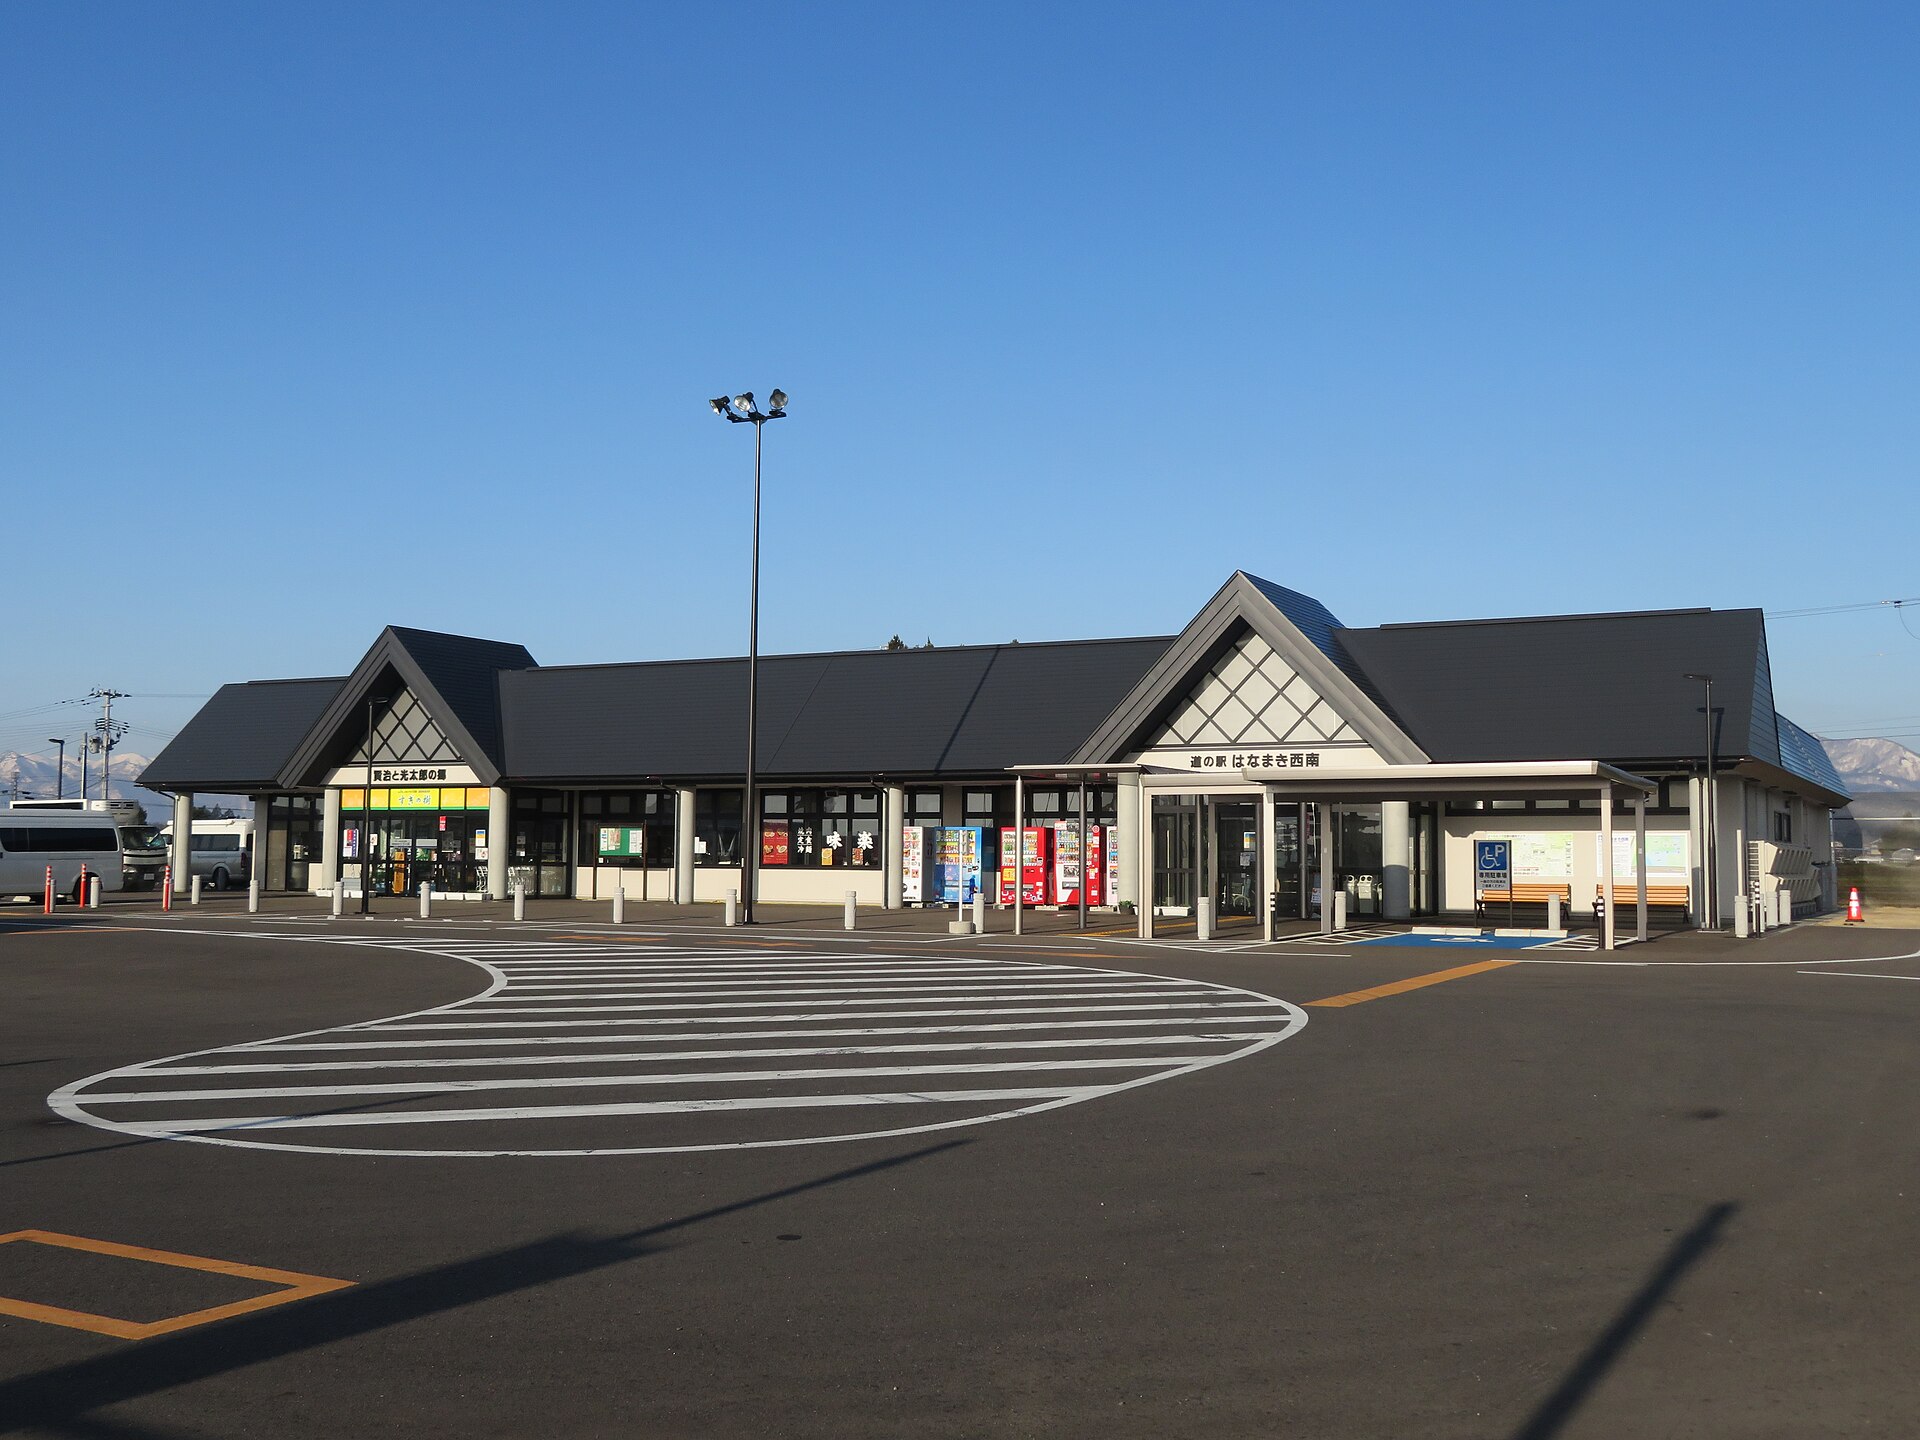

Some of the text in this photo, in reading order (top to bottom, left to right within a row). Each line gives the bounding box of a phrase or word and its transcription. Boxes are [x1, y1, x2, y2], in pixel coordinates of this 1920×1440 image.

[1190, 753, 1320, 768] 道の駅 はなまき西南
[373, 769, 446, 781] 賢治と光太郎の郷
[1495, 844, 1505, 857] P
